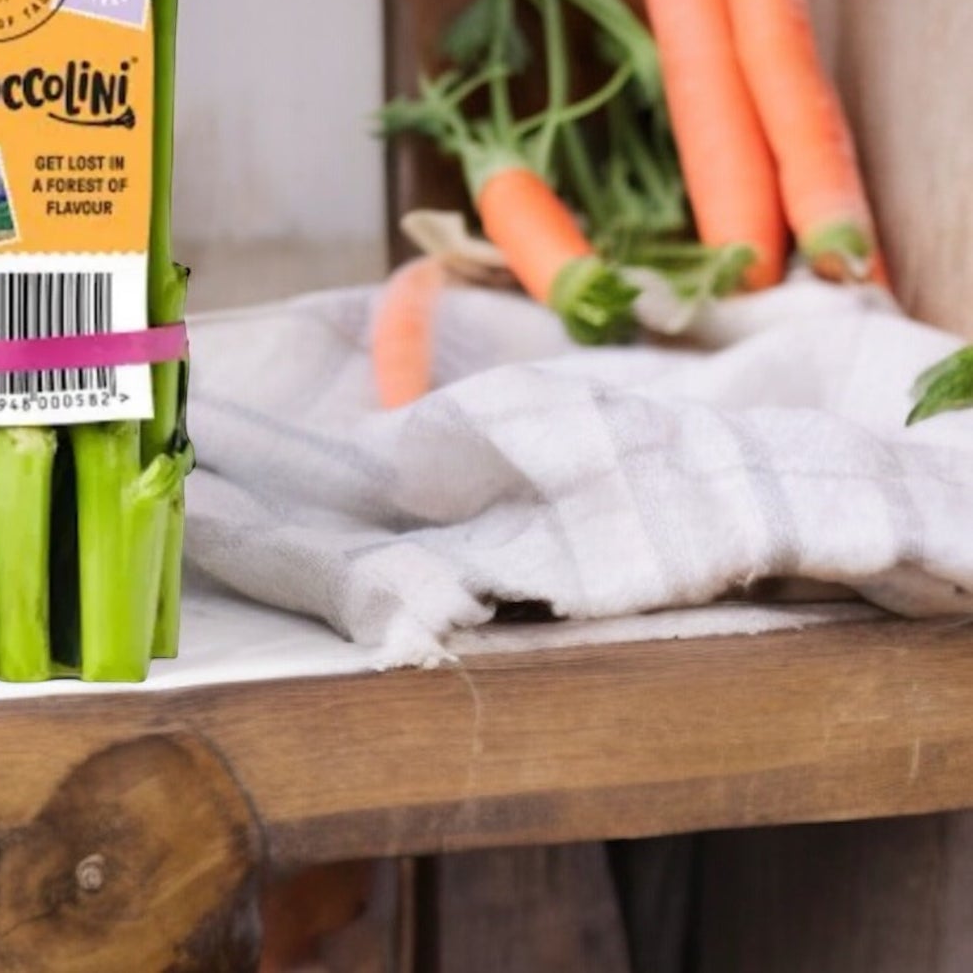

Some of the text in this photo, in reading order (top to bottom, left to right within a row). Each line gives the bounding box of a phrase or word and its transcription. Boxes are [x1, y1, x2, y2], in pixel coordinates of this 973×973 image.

[35, 156, 125, 171] GET LOST IN
[32, 178, 128, 193] A FOREST OF
[46, 200, 113, 215] FLAVOUR
